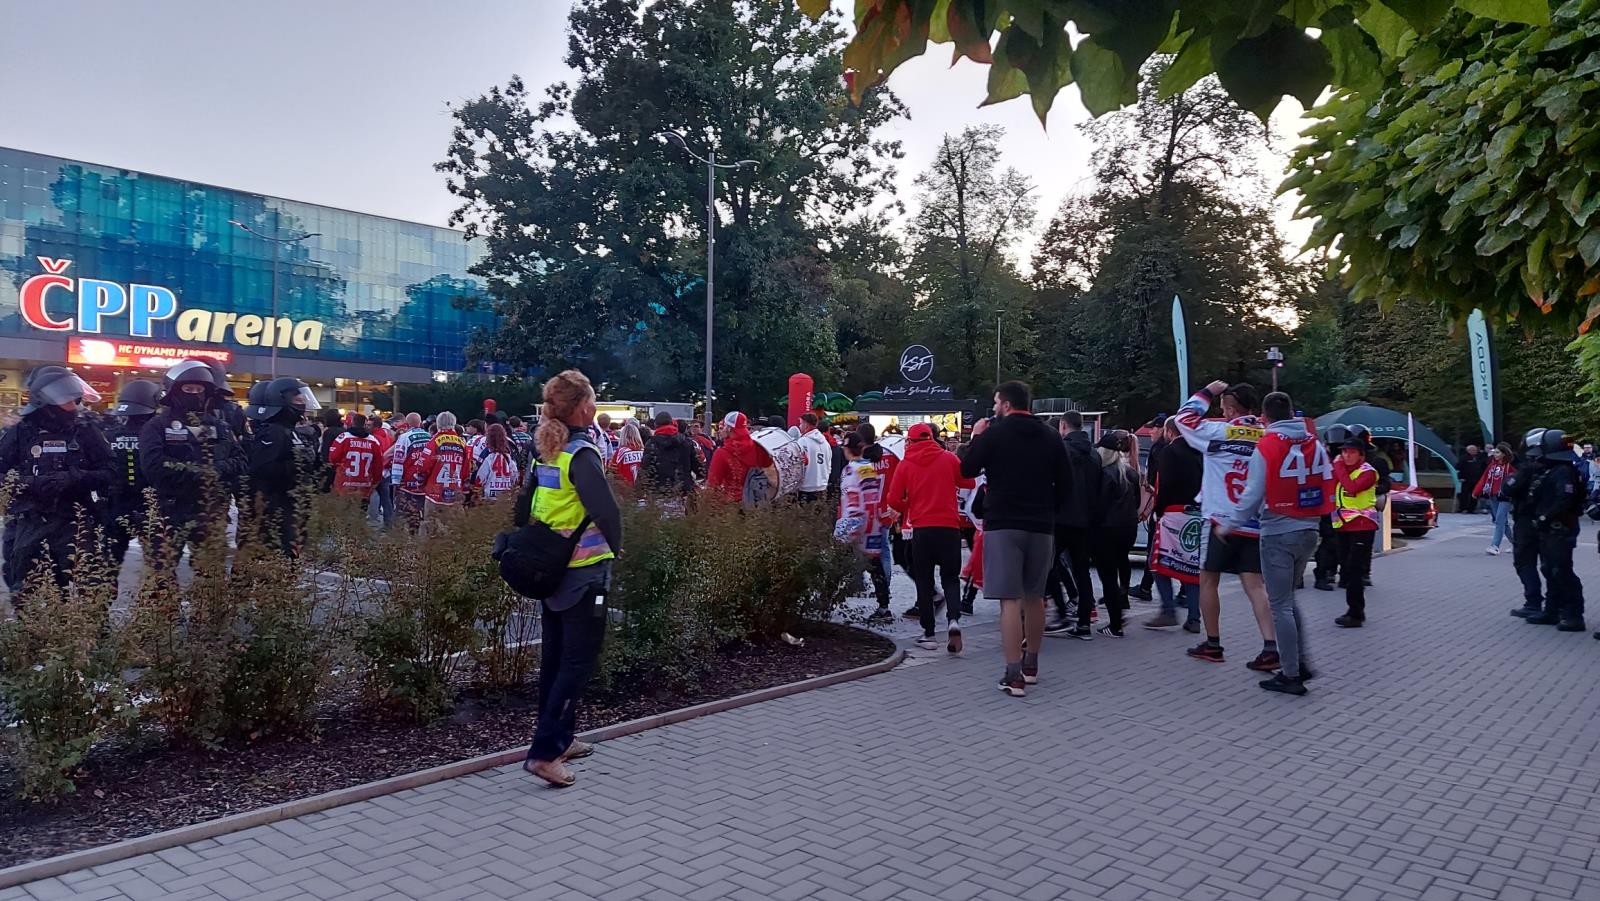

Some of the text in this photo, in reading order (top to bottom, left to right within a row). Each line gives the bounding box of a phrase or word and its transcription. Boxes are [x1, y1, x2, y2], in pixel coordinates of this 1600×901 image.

[19, 256, 324, 351] ČPP arena
[118, 345, 134, 354] HC
[134, 347, 176, 357] DYNAMO
[900, 354, 934, 371] KSF
[908, 386, 930, 395] Street
[930, 386, 951, 394] Food
[346, 451, 374, 478] 37
[817, 453, 825, 465] S
[1278, 440, 1334, 485] 44
